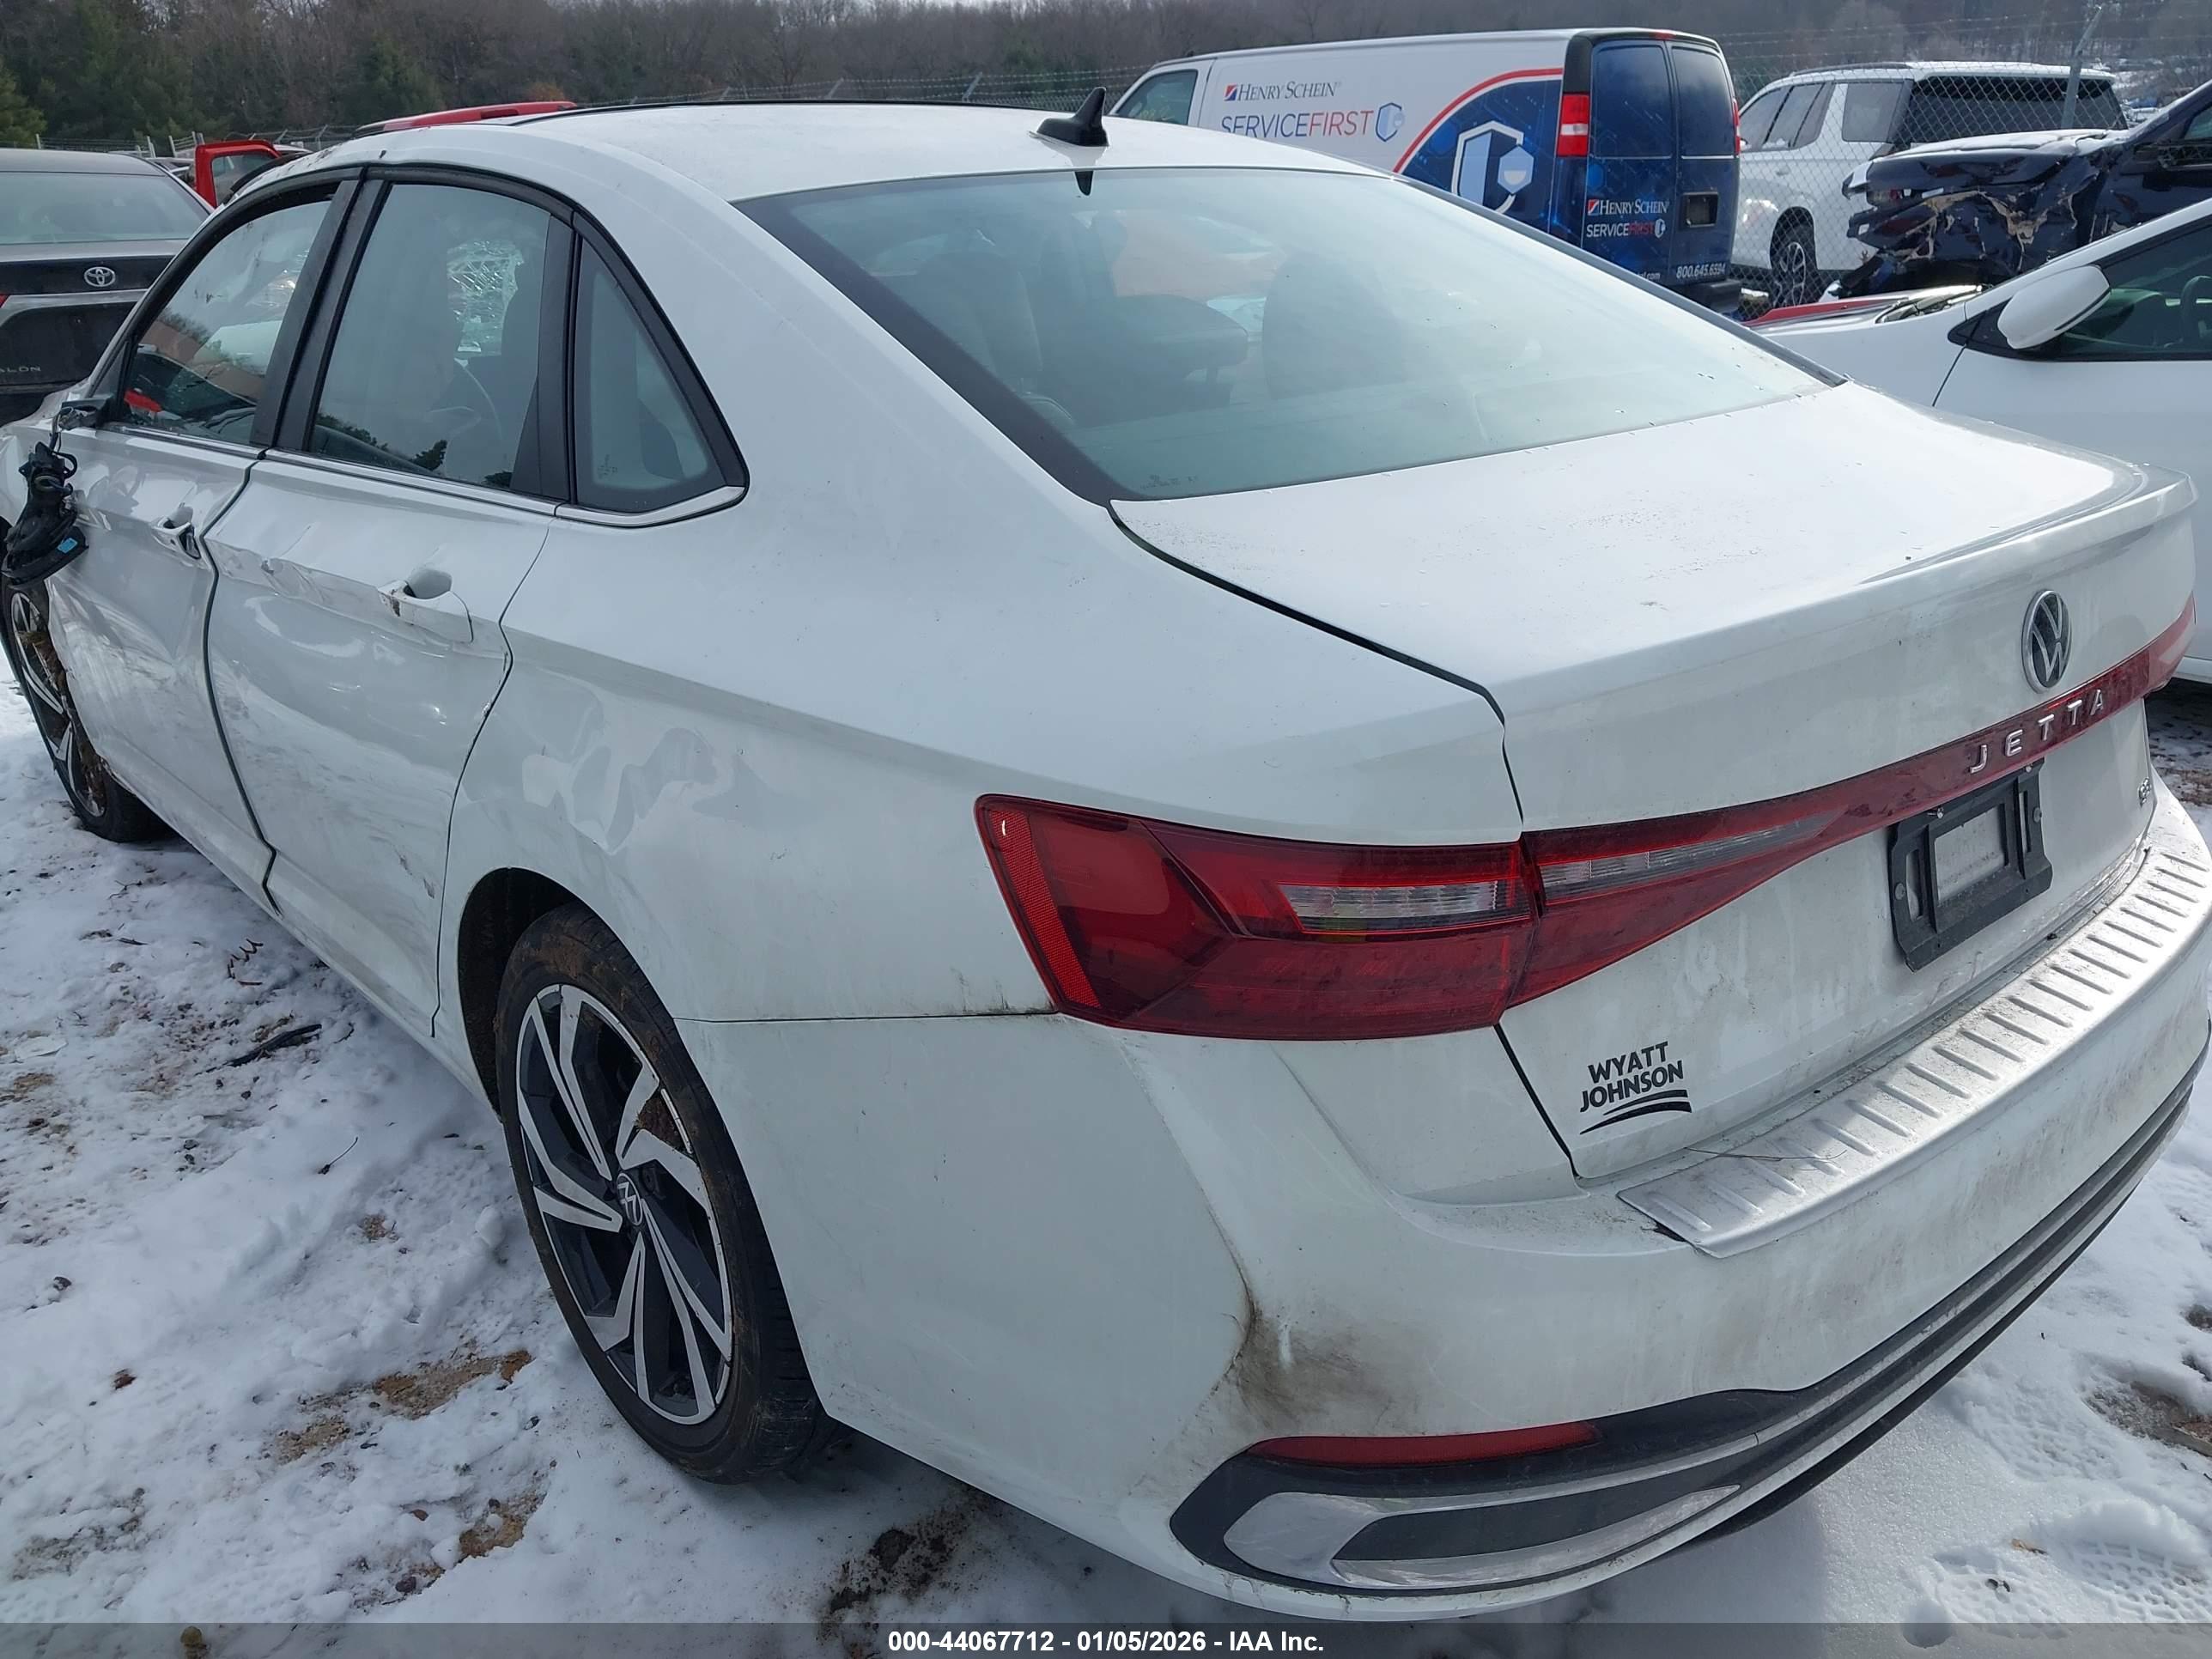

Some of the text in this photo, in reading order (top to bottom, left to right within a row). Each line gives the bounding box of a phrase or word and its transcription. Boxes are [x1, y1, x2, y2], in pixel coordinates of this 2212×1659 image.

[1237, 81, 1337, 101] HENRY SCHEIN
[1600, 198, 1667, 215] HENRY SCHEIN
[1969, 689, 2104, 774] JETTA
[1588, 1041, 1668, 1084] WYATT
[1579, 1060, 1684, 1113] JOHNSON
